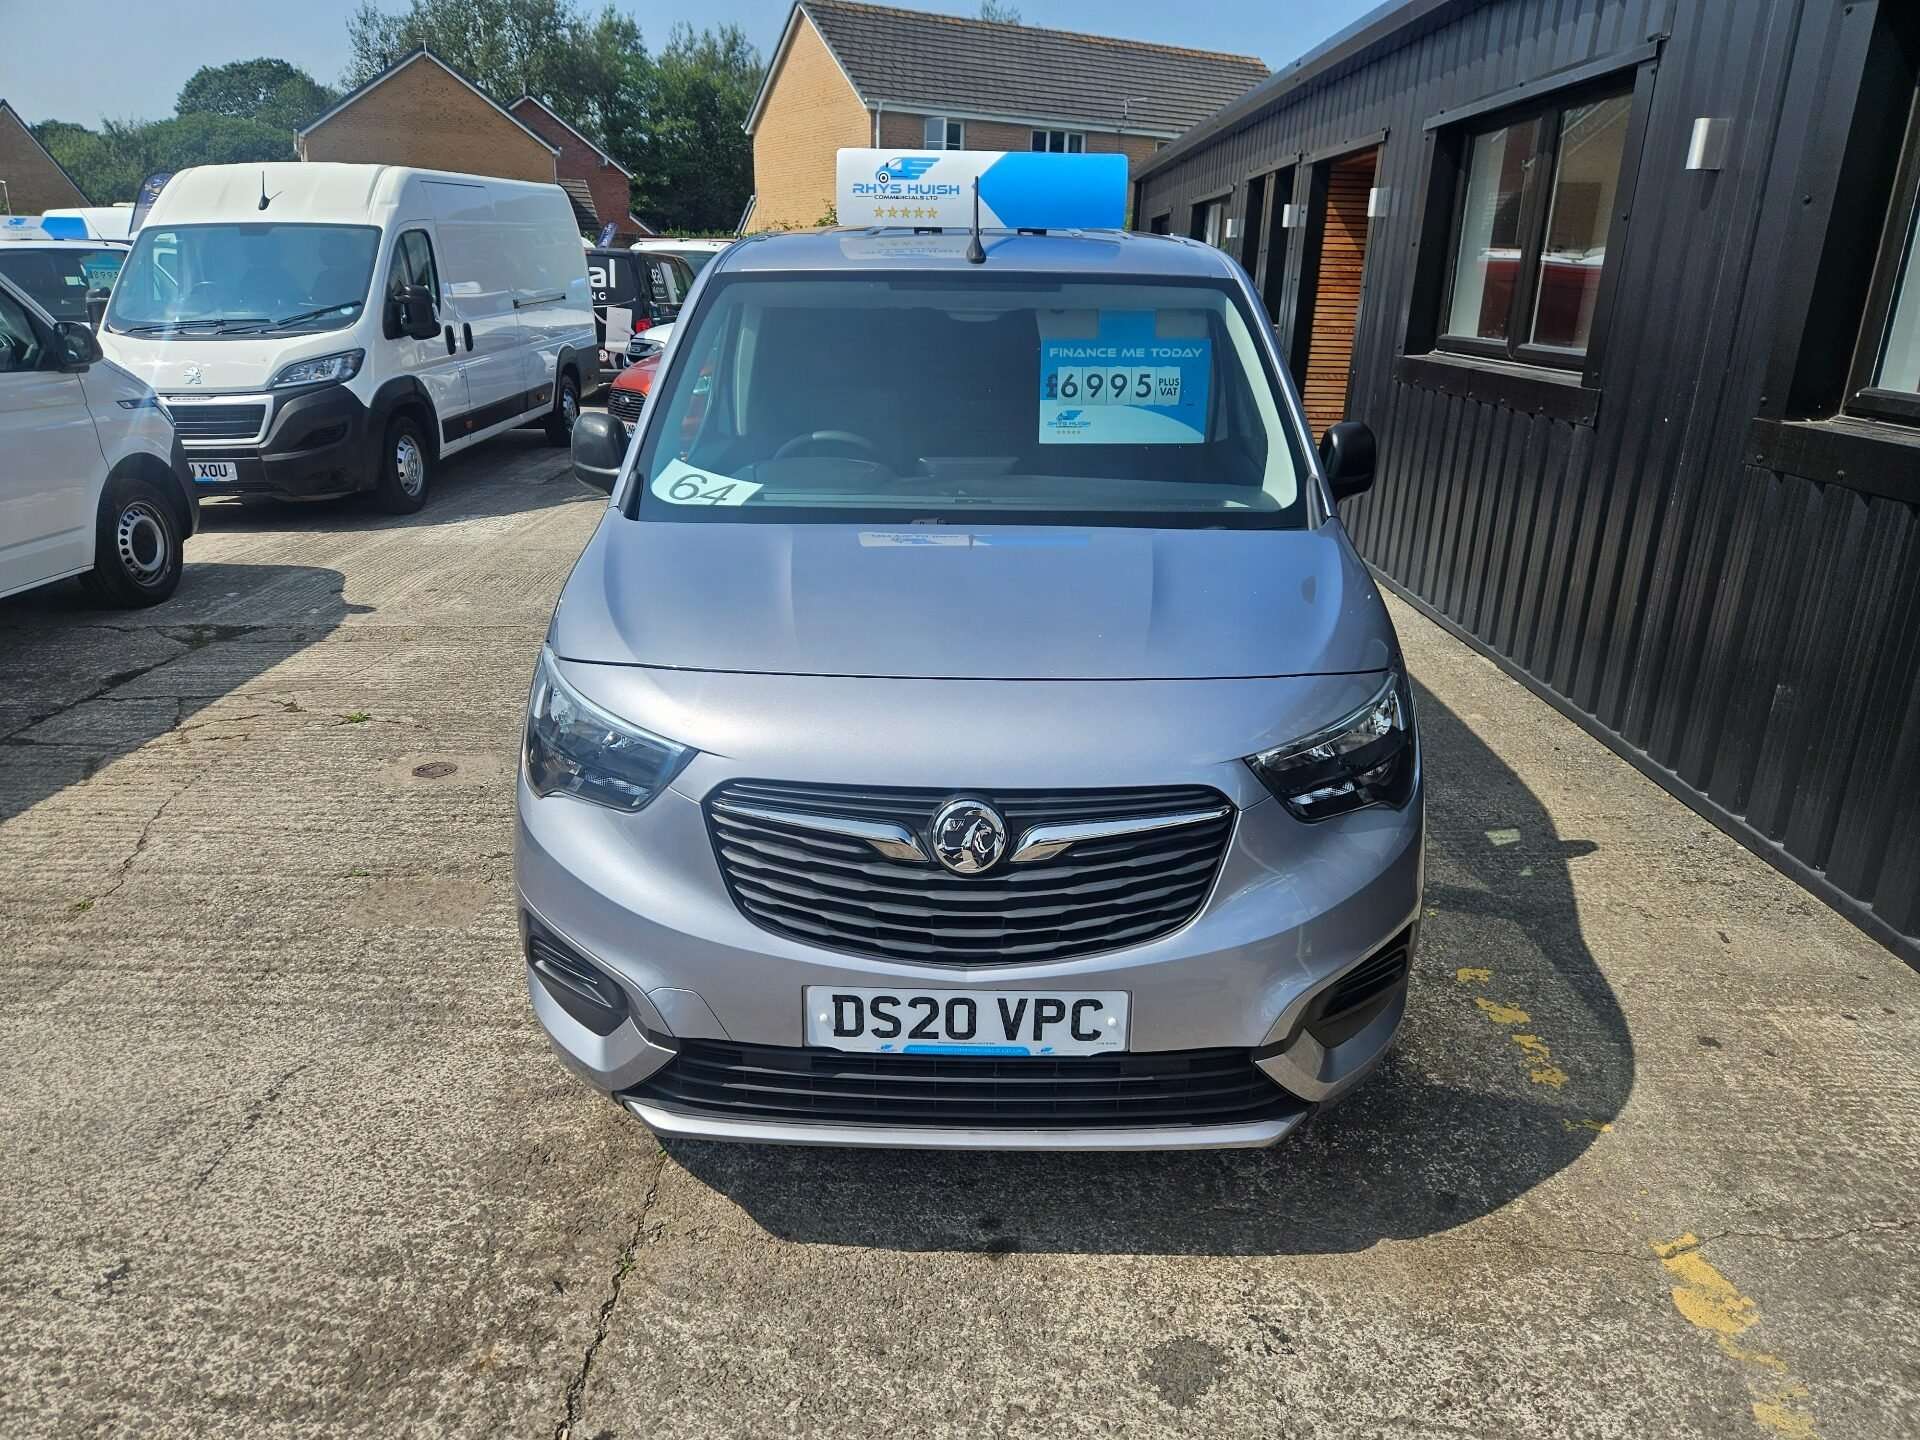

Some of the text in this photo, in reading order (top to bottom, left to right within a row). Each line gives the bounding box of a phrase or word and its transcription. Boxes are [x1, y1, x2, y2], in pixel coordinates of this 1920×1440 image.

[853, 183, 960, 195] RHYS HUISH
[1050, 347, 1203, 358] FINANCE ME TODAY
[1046, 373, 1152, 399] £6995
[1158, 377, 1180, 387] PLUS
[1160, 387, 1178, 397] VAT
[199, 464, 228, 478] XOU
[669, 473, 738, 506] 64
[831, 994, 1105, 1042] DS20 VPC
